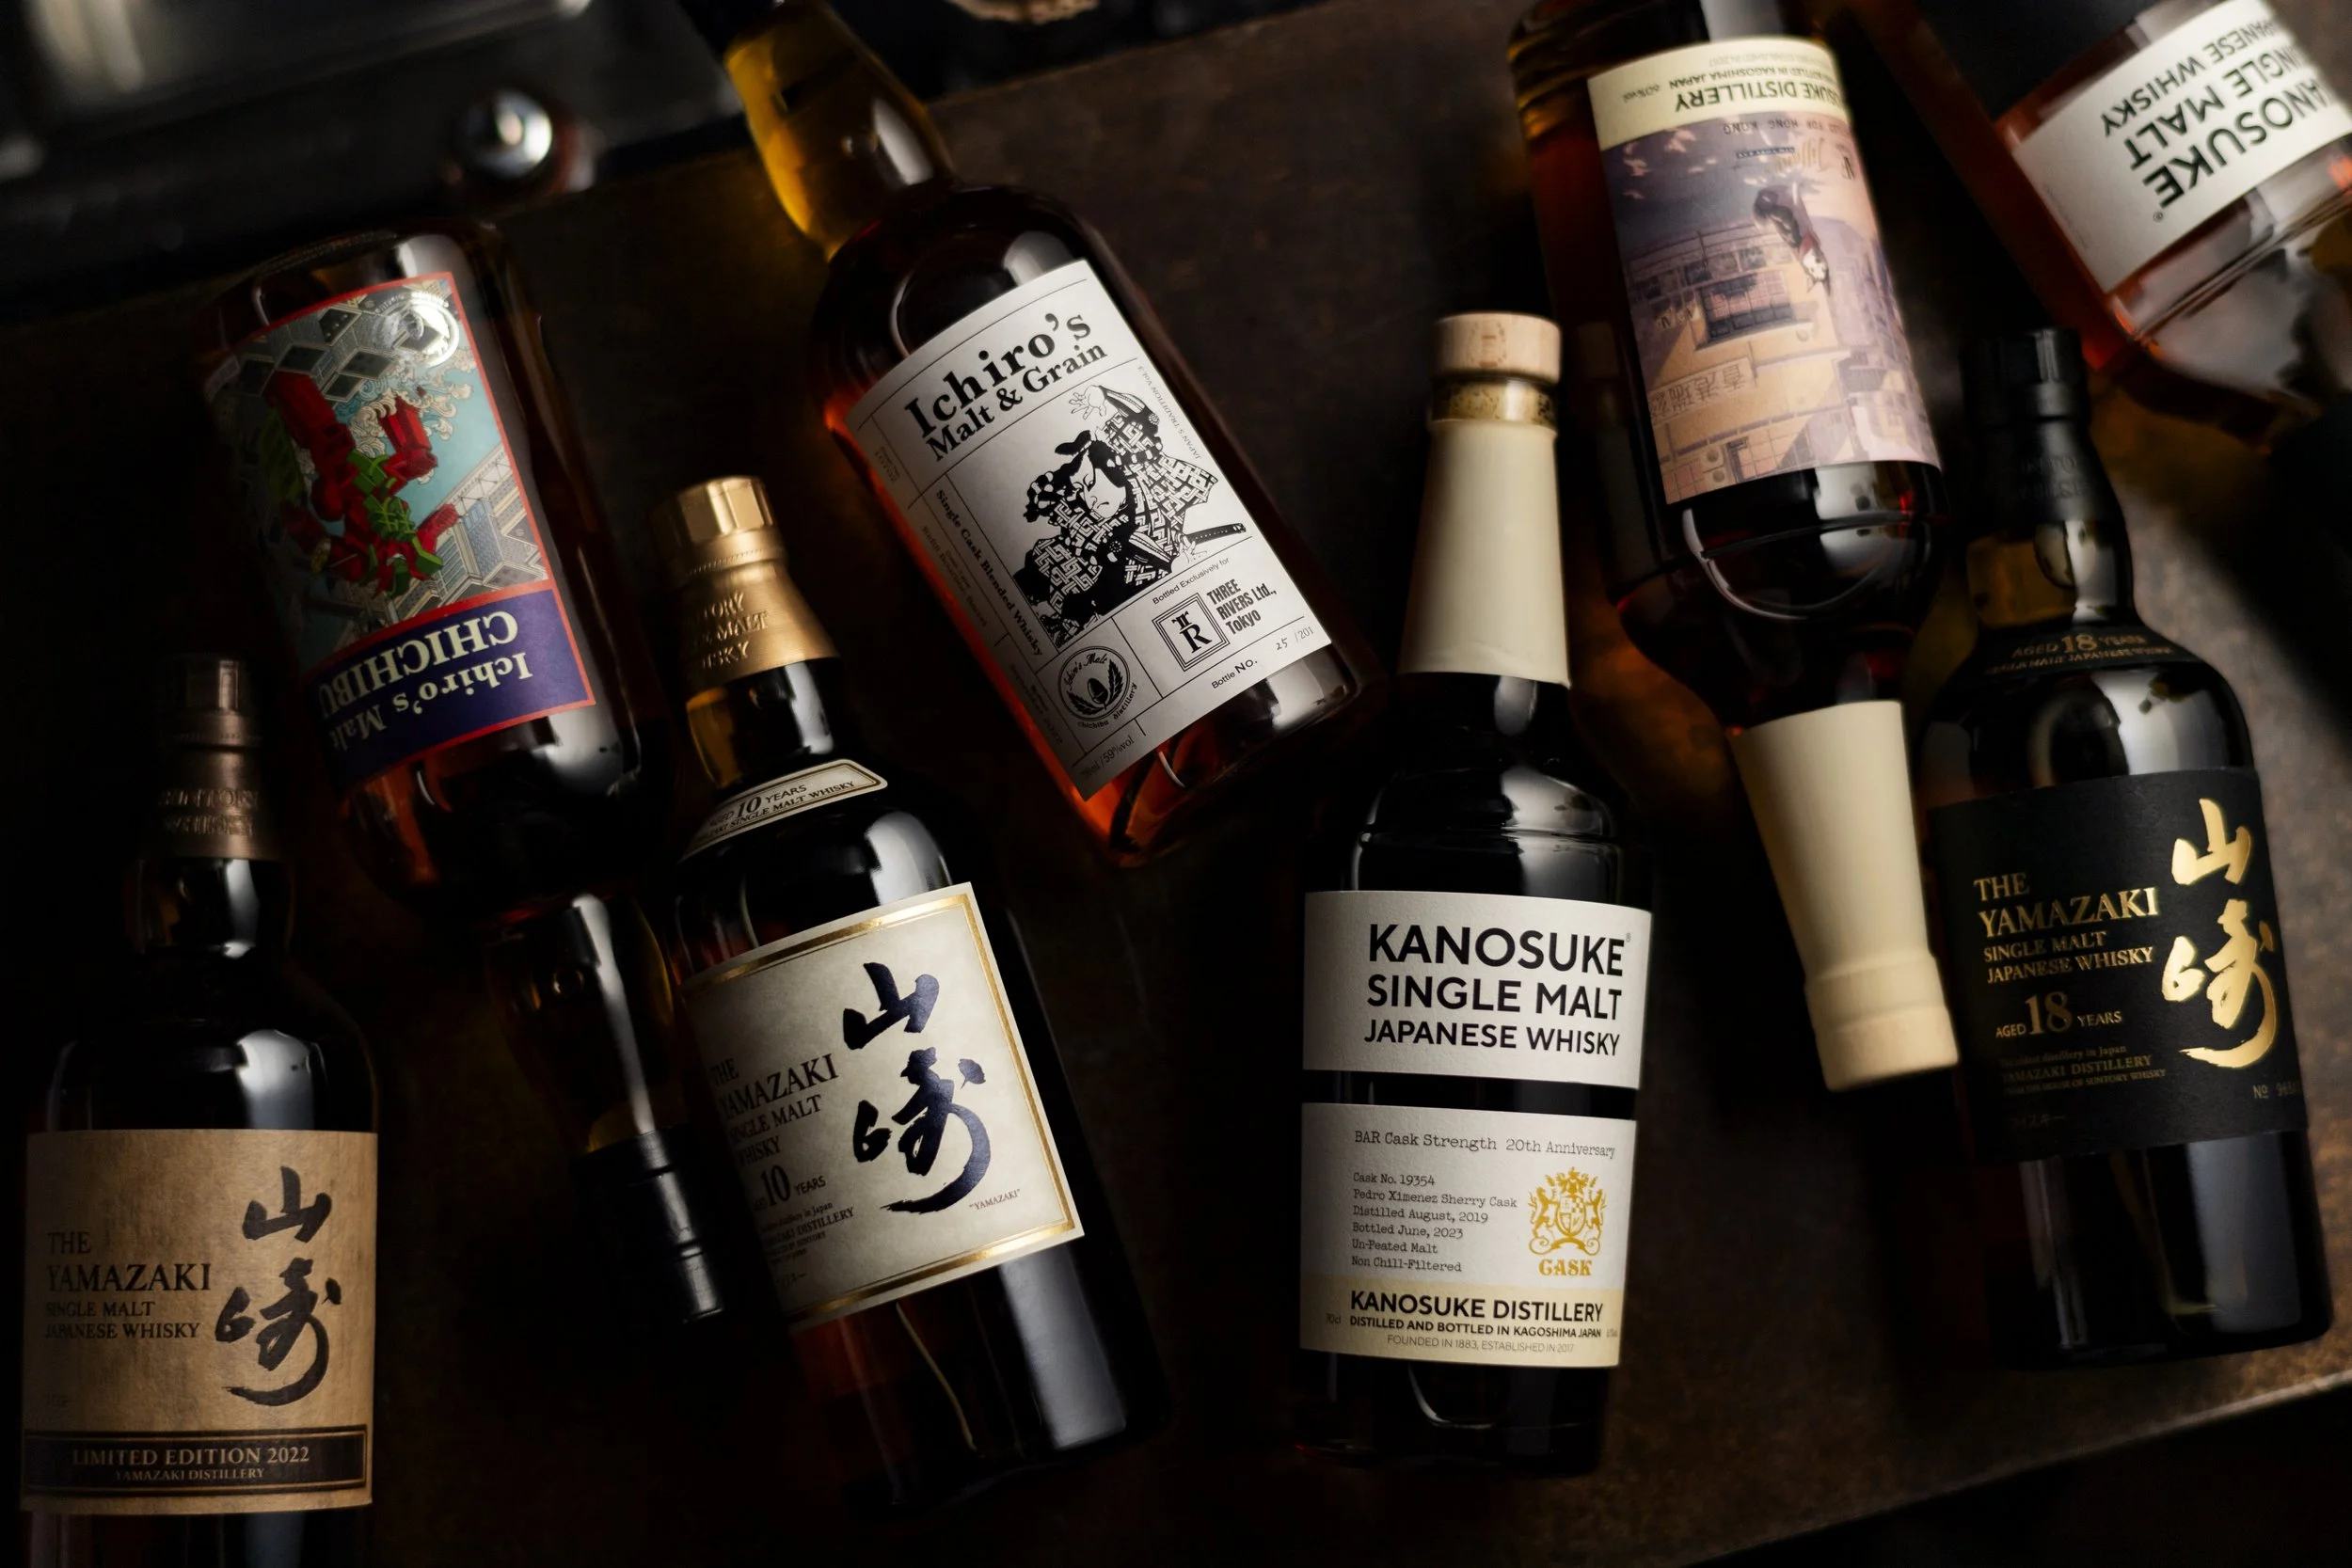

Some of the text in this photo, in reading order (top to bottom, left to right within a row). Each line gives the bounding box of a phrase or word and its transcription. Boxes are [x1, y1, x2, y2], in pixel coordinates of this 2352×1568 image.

[1669, 74, 1707, 89] JAPAN
[1708, 67, 1774, 82] KAGOSHIMA
[1675, 81, 1798, 113] DISTILLERY
[2101, 56, 2206, 136] WHISKY
[2124, 85, 2225, 170] MALT
[2142, 78, 2330, 209] ANOSUKE
[904, 312, 1092, 438] Ichiro's
[926, 405, 994, 462] Malt
[995, 388, 1023, 412] &
[1023, 344, 1107, 393] Grain
[936, 489, 961, 529] Single
[961, 529, 982, 561] Cask
[980, 561, 1015, 611] Blended
[1013, 611, 1042, 657] Whisky
[1152, 557, 1230, 605] Bottled Exclusively for
[1206, 578, 1241, 605] THREE
[1216, 593, 1254, 620] RIVERS
[1225, 610, 1262, 635] Tokyo
[2011, 641, 2059, 658] AGED
[2060, 633, 2098, 654] 18
[318, 610, 518, 719] CHICHIBU
[1211, 671, 1236, 689] Bottle
[1234, 659, 1258, 673] No.
[328, 652, 532, 752] Ichiro's Malt
[729, 781, 855, 828] SINGLE MALT WHISKY
[736, 797, 762, 818] 10
[766, 784, 807, 803] YEARS
[1973, 872, 2030, 902] THE
[1979, 886, 2159, 940] YAMAZAKI
[1369, 923, 1625, 976] KANOSUKE
[1983, 930, 2106, 963] SINGLE MALT
[1987, 946, 2153, 985] JAPANESE WHISKY
[1367, 974, 1622, 1021] SINGLE MALT
[1995, 990, 2123, 1039] AGED 18 YEARS
[1364, 1019, 1620, 1056] JAPANESE WHISKY
[2086, 1047, 2096, 1056] in
[2098, 1046, 2127, 1057] Japan
[710, 1058, 739, 1086] THE
[2002, 1054, 2153, 1083] YAMAZAKI DISTILLERY
[718, 1053, 839, 1120] YAMAZAKI
[771, 1094, 821, 1126] MALT
[1355, 1130, 1616, 1160] BAR Cask Strength 20th Anniversary
[761, 1164, 790, 1207] 10
[794, 1175, 826, 1196] YEARS
[1353, 1172, 1435, 1186] Cask No. 19354
[813, 1202, 834, 1215] Japan
[1353, 1188, 1518, 1209] Pedro Ximenez Sherry Cask
[797, 1207, 854, 1236] DISTILLERY
[1353, 1205, 1488, 1223] Distilled August, 2019
[48, 1231, 92, 1254] THE
[1352, 1222, 1464, 1239] Bottled June, 2023
[1352, 1239, 1438, 1254] Un-Peated Malt
[48, 1263, 212, 1291] YAMAZAKI
[1351, 1256, 1462, 1273] Non Chill-Filtered
[46, 1301, 155, 1317] SINGLE MALT
[1350, 1291, 1603, 1323] KANOSUKE DISTILLERY
[45, 1323, 201, 1338] JAPANESE WHISKY
[1350, 1316, 1404, 1329] DISTILLED
[1406, 1320, 1434, 1332] AND
[1438, 1322, 1493, 1335] BOTTLED
[1497, 1325, 1510, 1335] IN
[1513, 1325, 1577, 1338] KAGOSHIMA
[1578, 1327, 1601, 1338] JAPAN
[1387, 1334, 1574, 1354] FOUNDED IN 1883, ESTABLISHED IN 2017
[72, 1446, 310, 1465] LIMITED EDITION 2022
[115, 1467, 264, 1481] YAMAZAKI DISTILLERY
